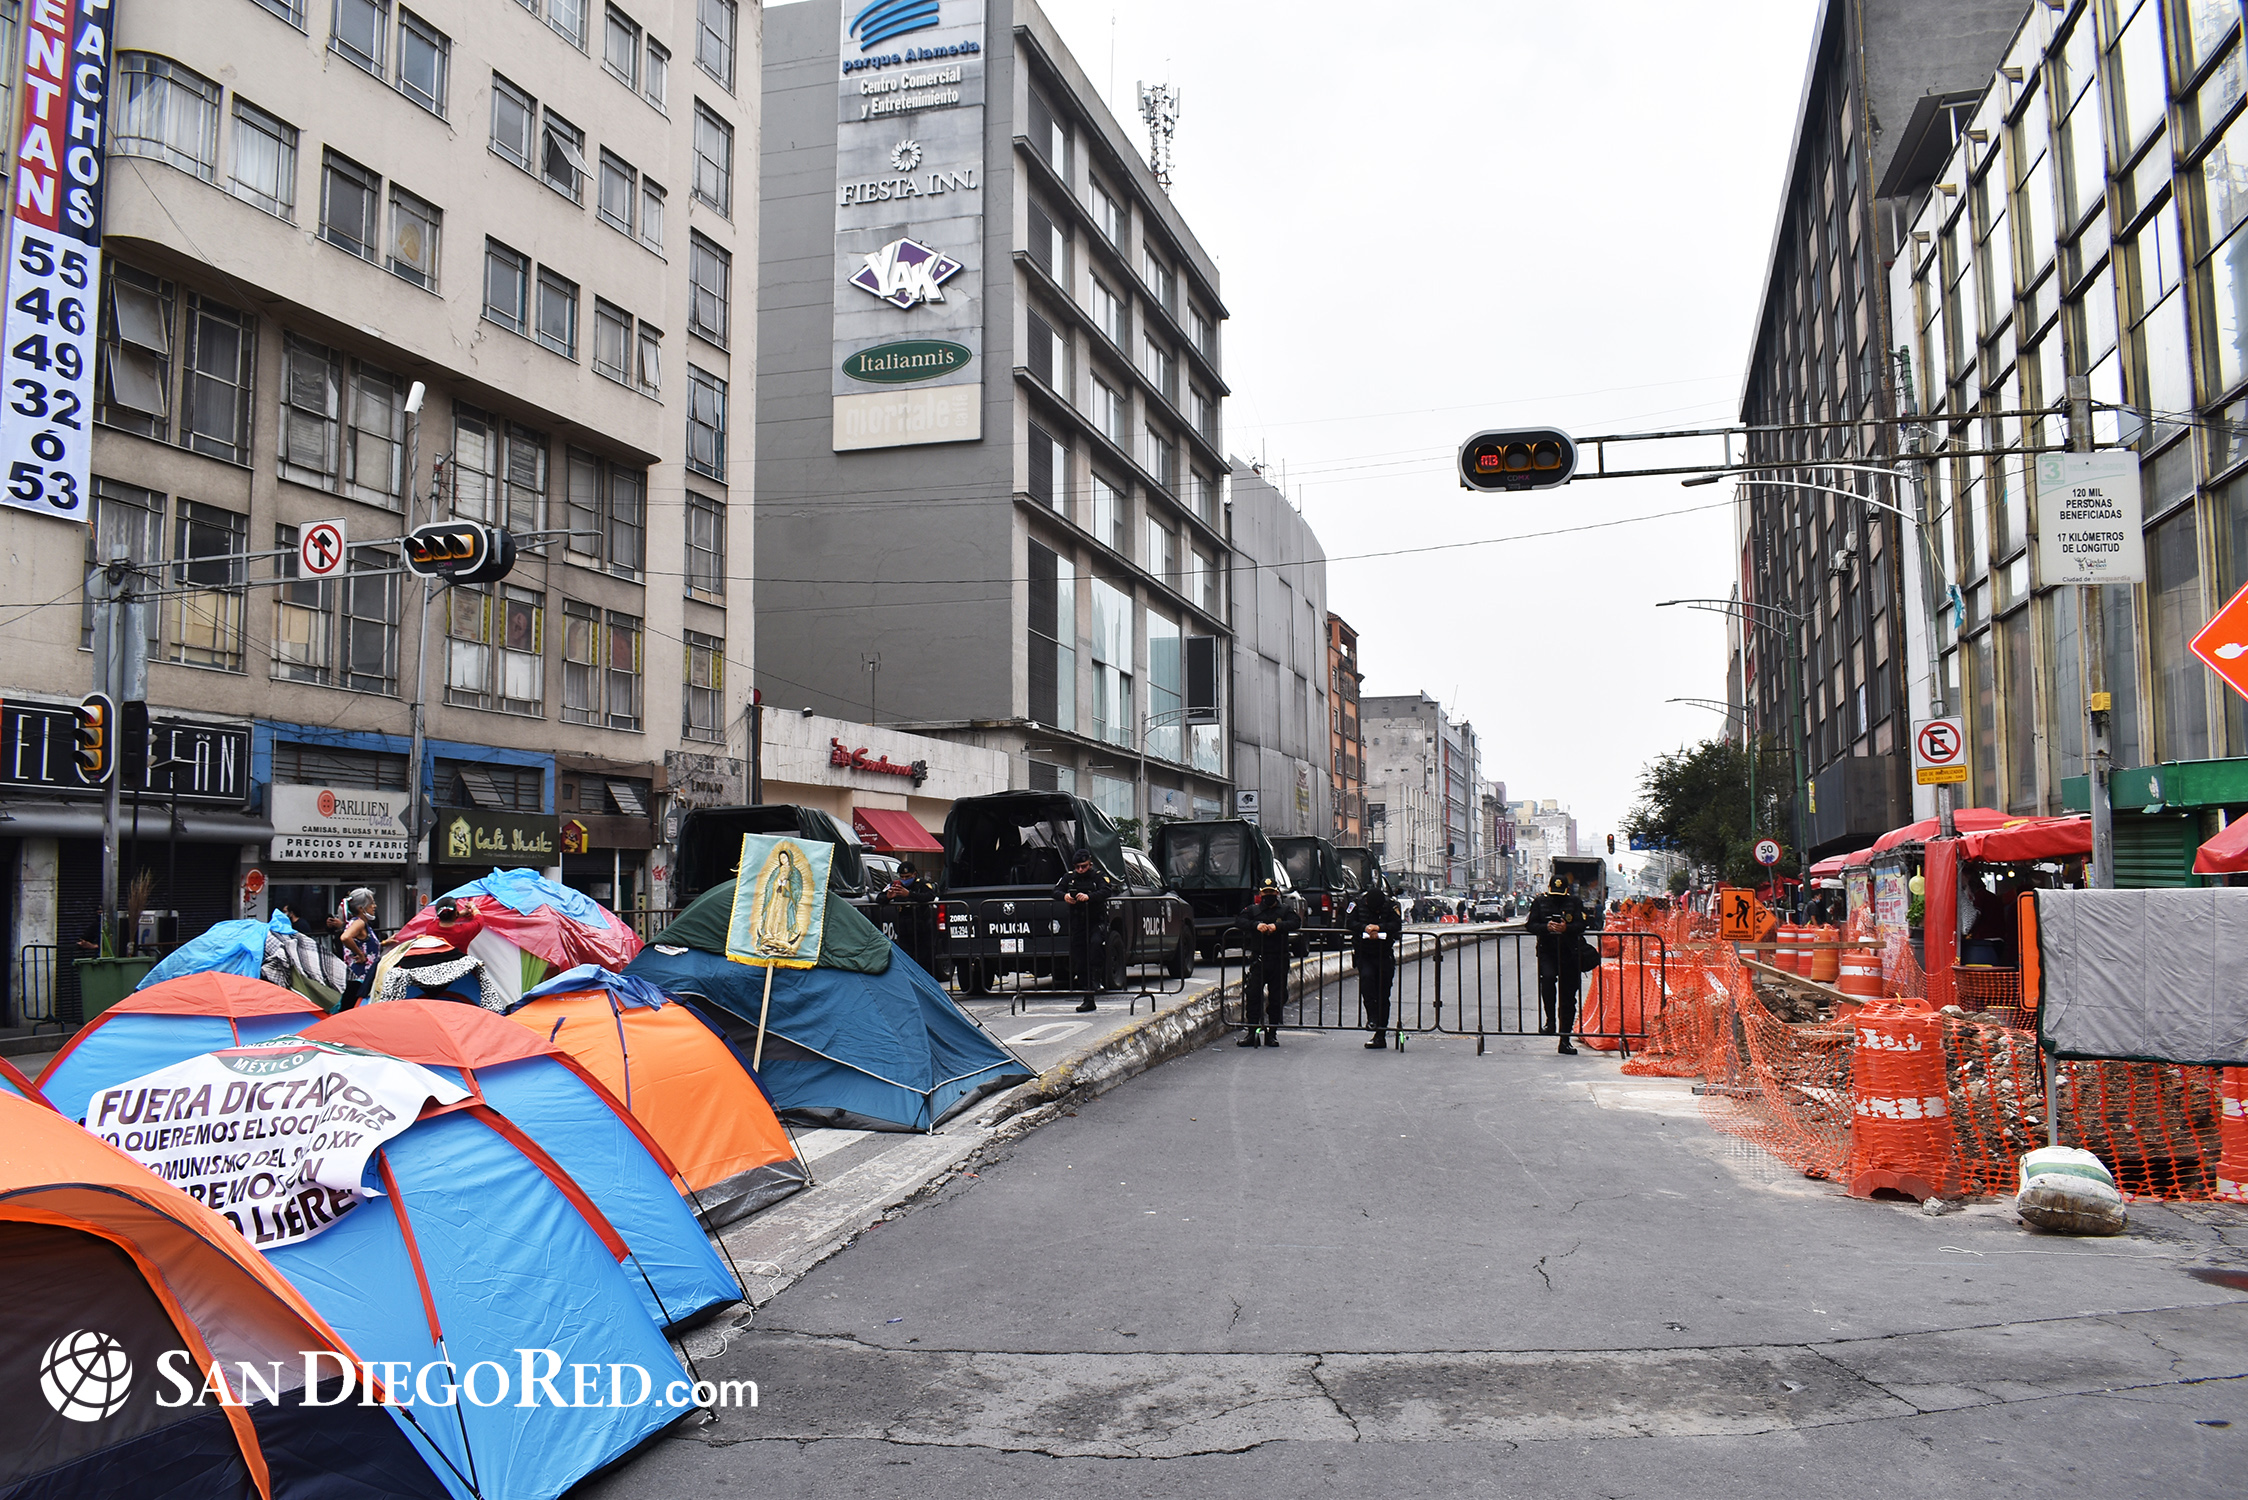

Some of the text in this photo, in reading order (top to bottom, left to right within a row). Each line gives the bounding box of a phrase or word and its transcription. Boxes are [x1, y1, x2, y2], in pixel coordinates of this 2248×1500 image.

[842, 40, 980, 73] parque Alameda
[860, 65, 961, 95] Centro Comercial
[861, 88, 959, 119] y Entretenimiento
[840, 177, 923, 206] FIESTA
[2045, 462, 2060, 480] 3
[2072, 488, 2103, 497] 120 MIL
[2066, 499, 2112, 508] PERSONAS
[2060, 510, 2122, 519] BENEFICIADAS
[2057, 531, 2124, 542] 17 KILÓMETROS
[2062, 543, 2120, 552] DE LONGITUD
[15, 713, 54, 781] EL
[342, 827, 371, 835] BLUSAS
[475, 827, 507, 850] Café
[287, 838, 342, 848] PRECIOS
[349, 840, 362, 848] DE
[1761, 845, 1773, 854] 50
[989, 922, 1031, 934] POLICIA
[233, 1054, 304, 1073] MÉXICO
[97, 1072, 396, 1127] FUERA DICTADOR
[124, 1121, 240, 1151] QUEREMOS
[243, 1118, 266, 1140] EL
[252, 1148, 286, 1168] DEL
[327, 1131, 364, 1150] XXI
